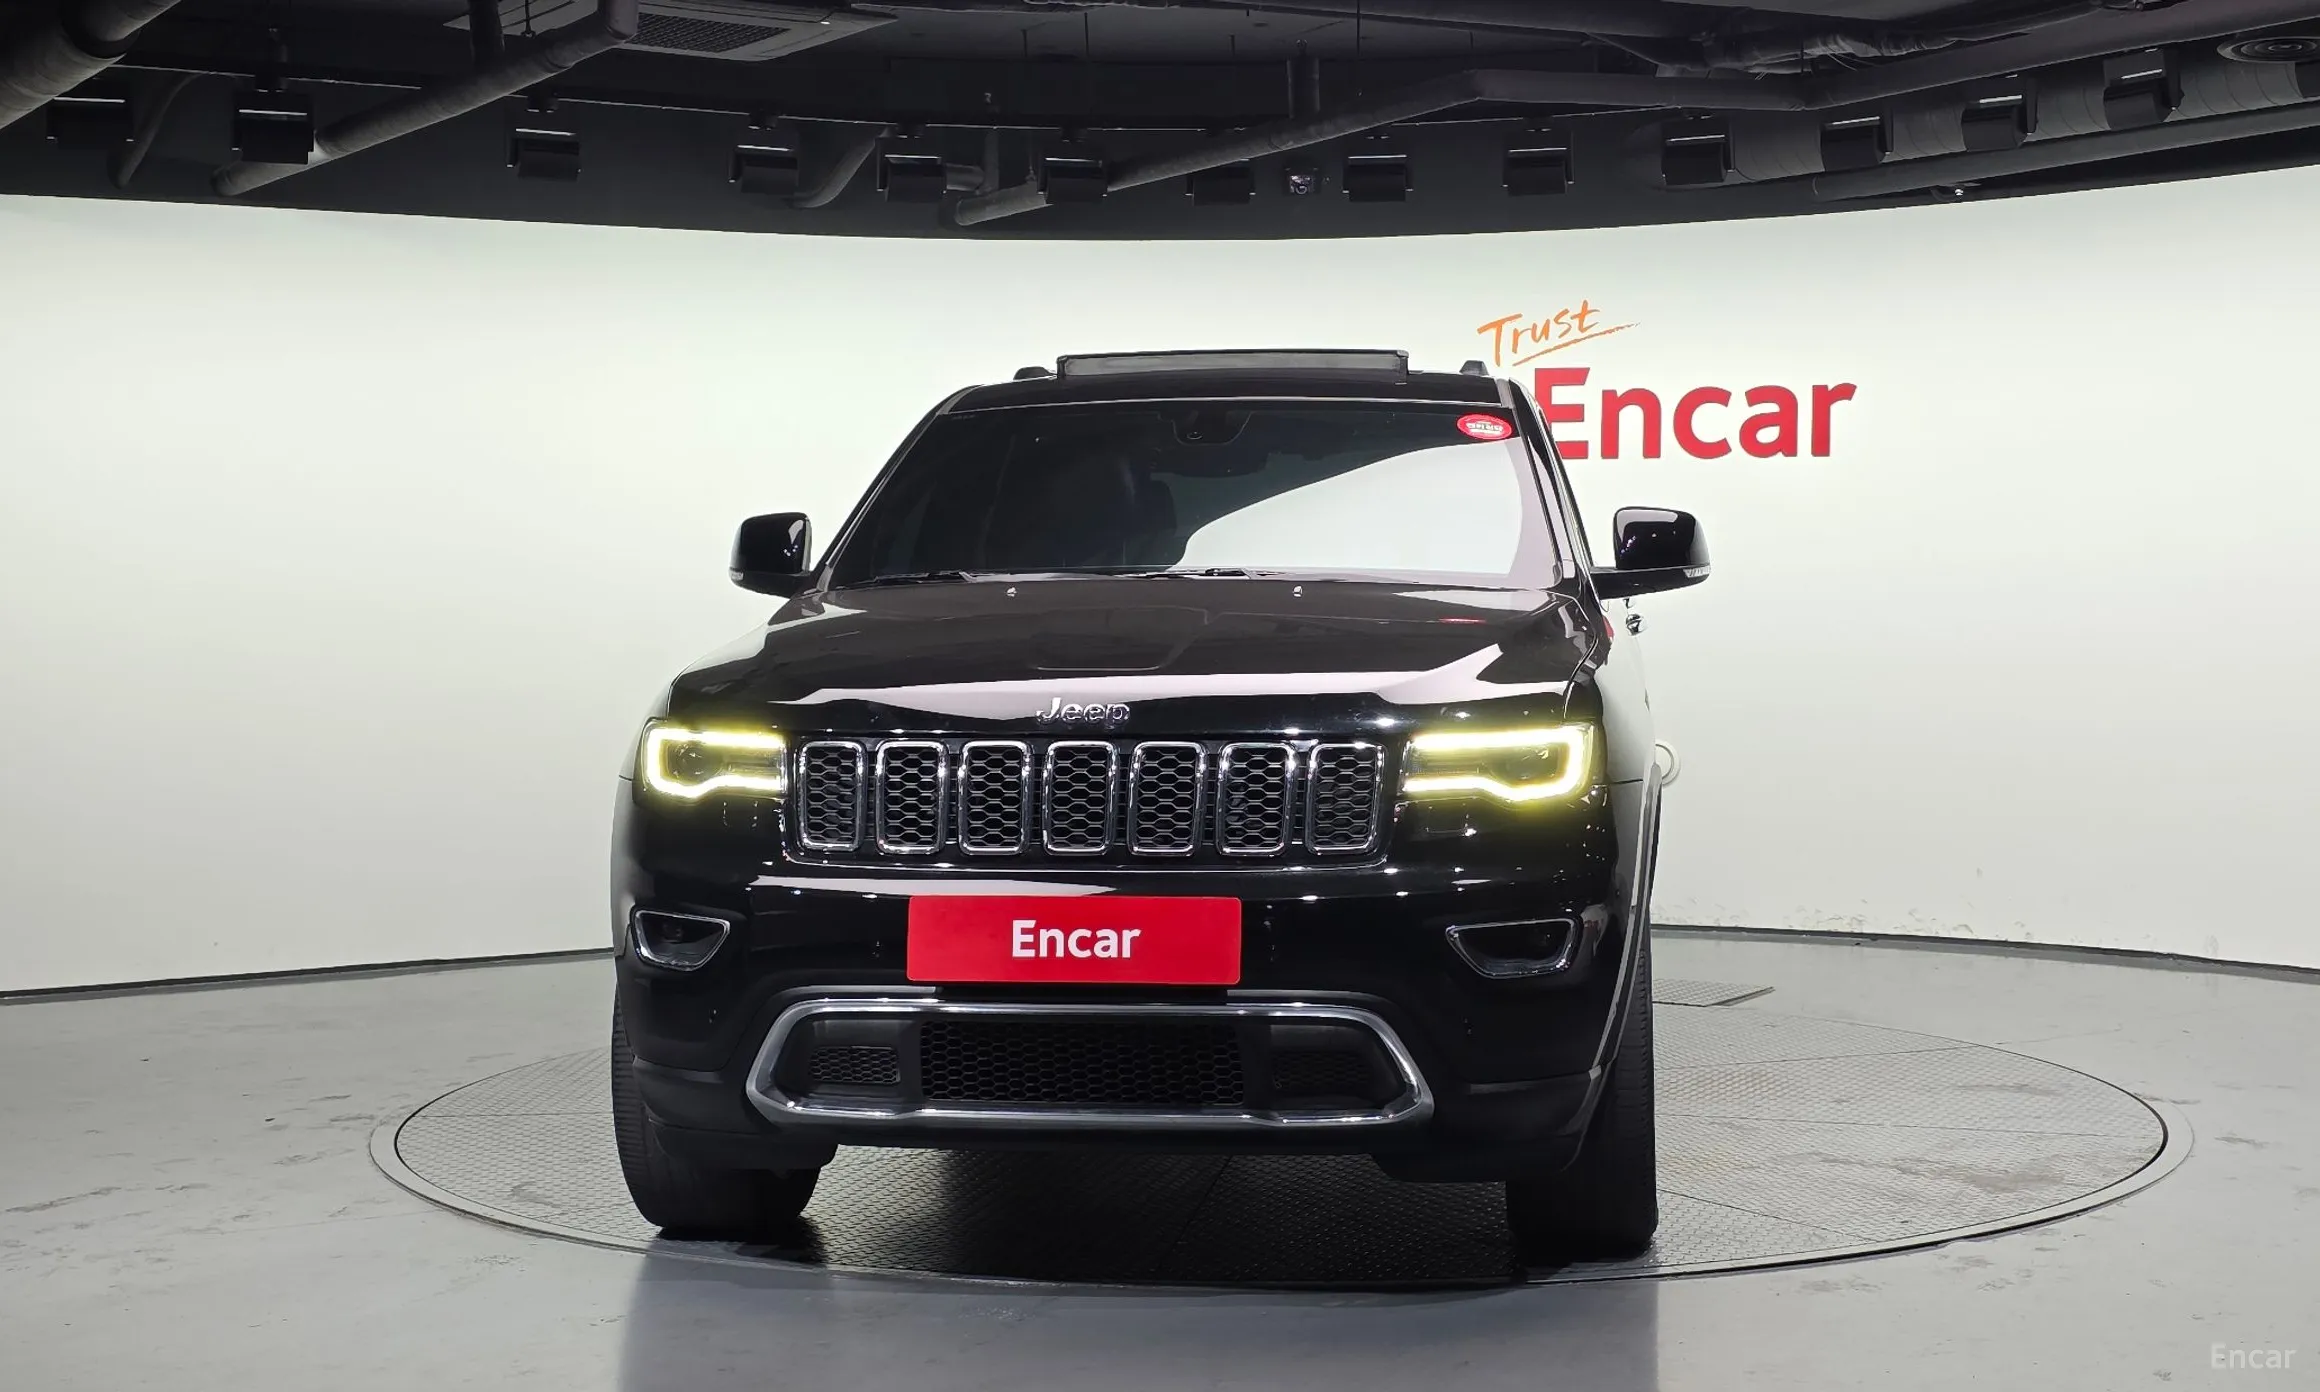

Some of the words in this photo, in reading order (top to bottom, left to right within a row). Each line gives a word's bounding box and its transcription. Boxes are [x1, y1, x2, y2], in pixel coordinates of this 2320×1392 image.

[1477, 300, 1601, 367] Trust
[1534, 366, 1858, 460] Encar
[1035, 697, 1131, 729] Jeep
[1011, 919, 1142, 959] Encar
